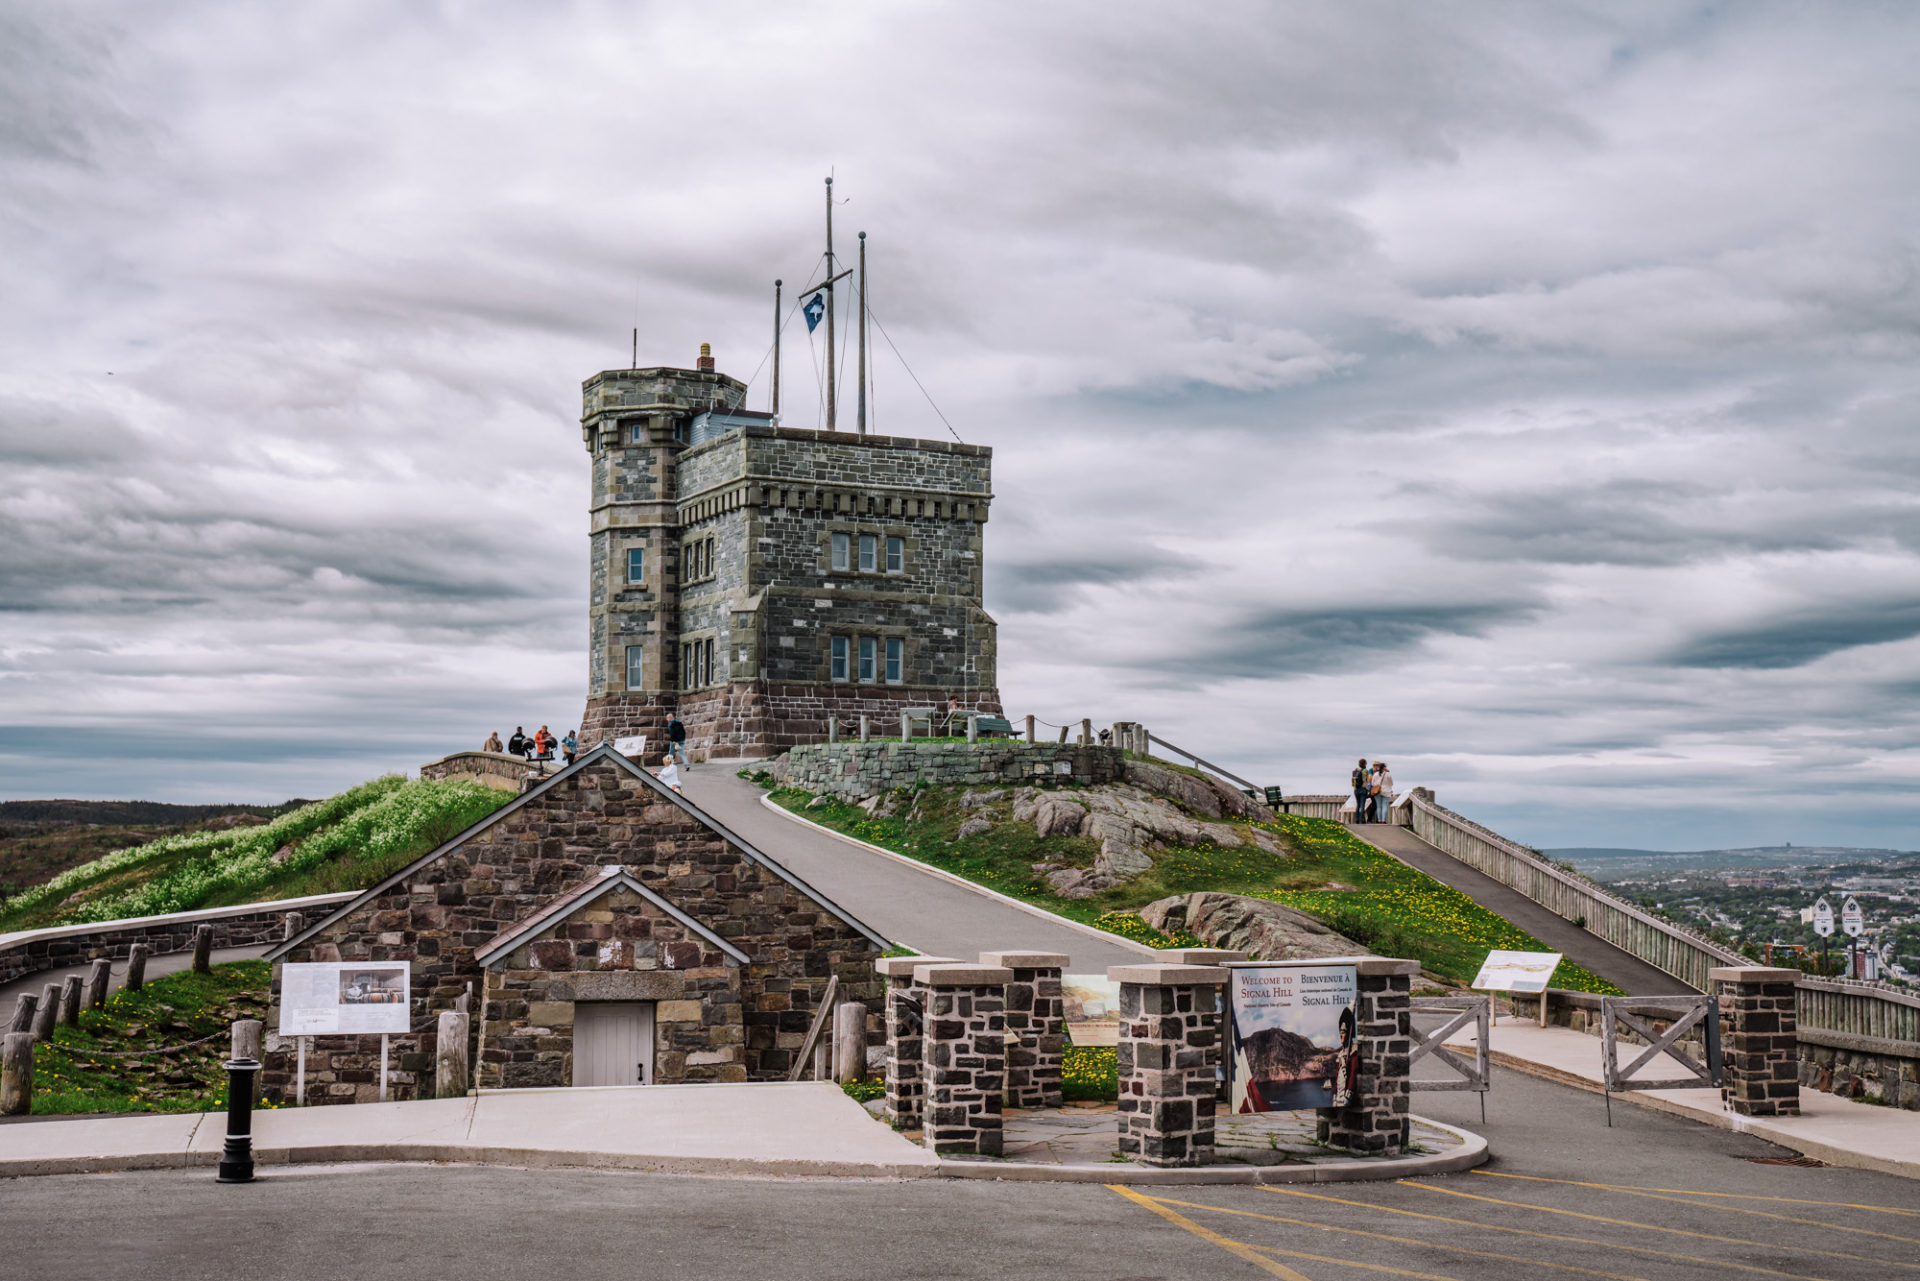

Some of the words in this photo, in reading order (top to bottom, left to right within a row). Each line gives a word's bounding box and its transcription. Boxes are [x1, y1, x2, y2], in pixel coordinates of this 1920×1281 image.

[1241, 976, 1280, 985] WELCOME
[1283, 976, 1292, 984] TO
[1301, 974, 1343, 984] BIENVENUE
[1345, 973, 1350, 982] À
[1241, 988, 1271, 999] SIGNAL
[1273, 987, 1293, 997] HILL
[1302, 996, 1331, 1006] SIGNAL
[1332, 995, 1351, 1005] HILL
